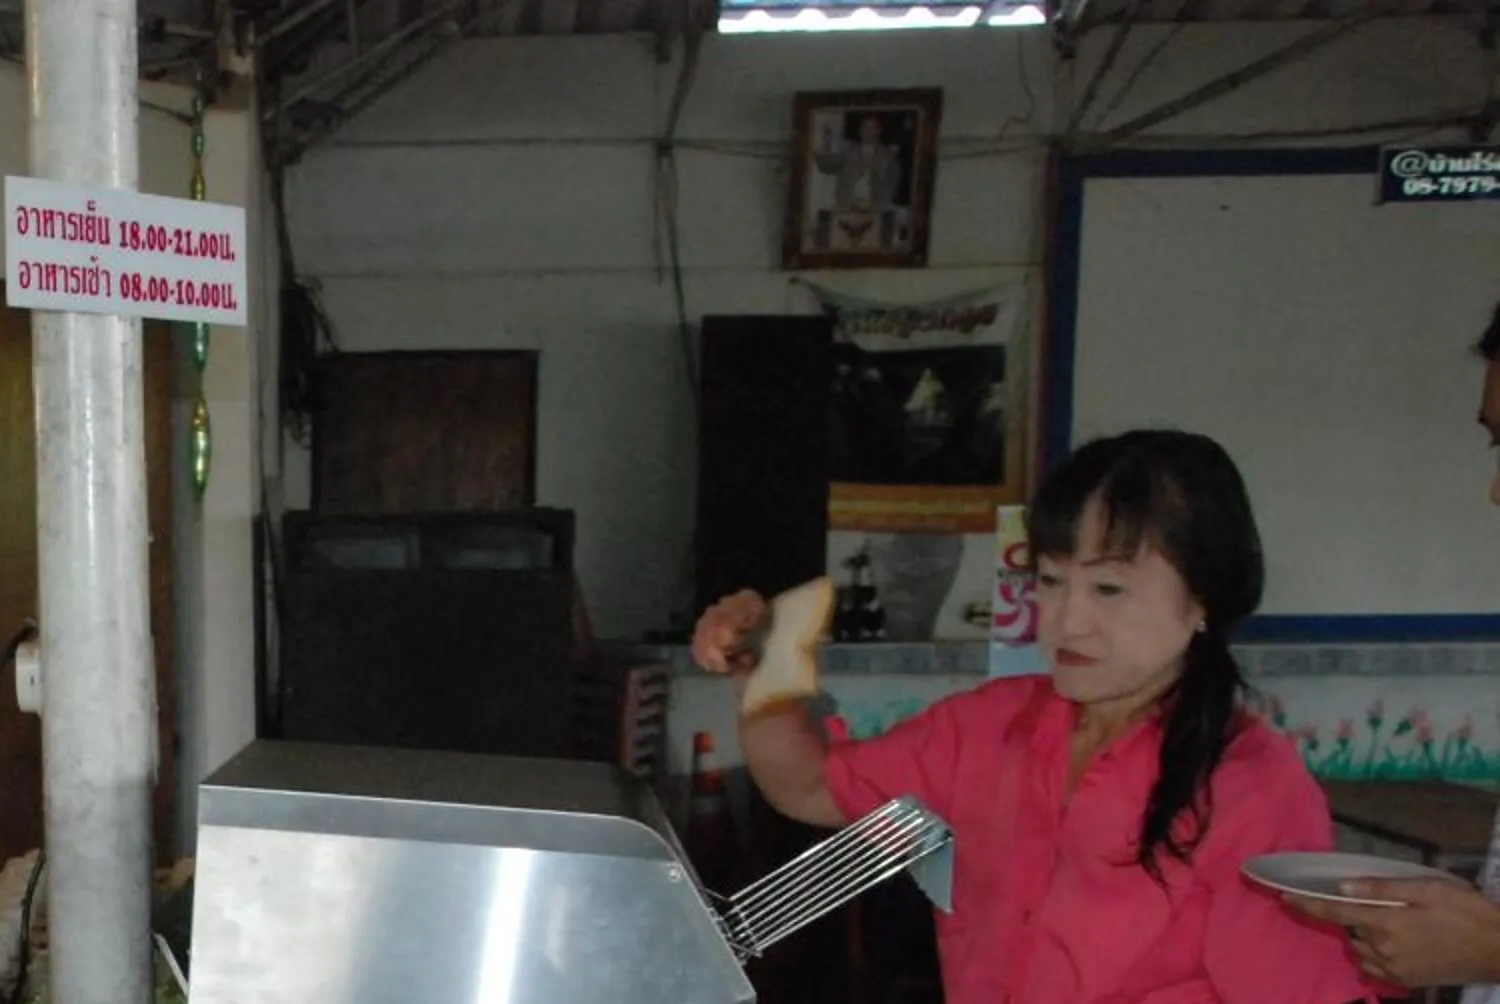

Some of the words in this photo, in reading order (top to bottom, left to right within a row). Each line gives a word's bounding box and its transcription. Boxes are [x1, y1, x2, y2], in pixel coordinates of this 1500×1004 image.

[16, 200, 110, 245] อาหารเย็น
[19, 256, 111, 297] อาหารเช้า
